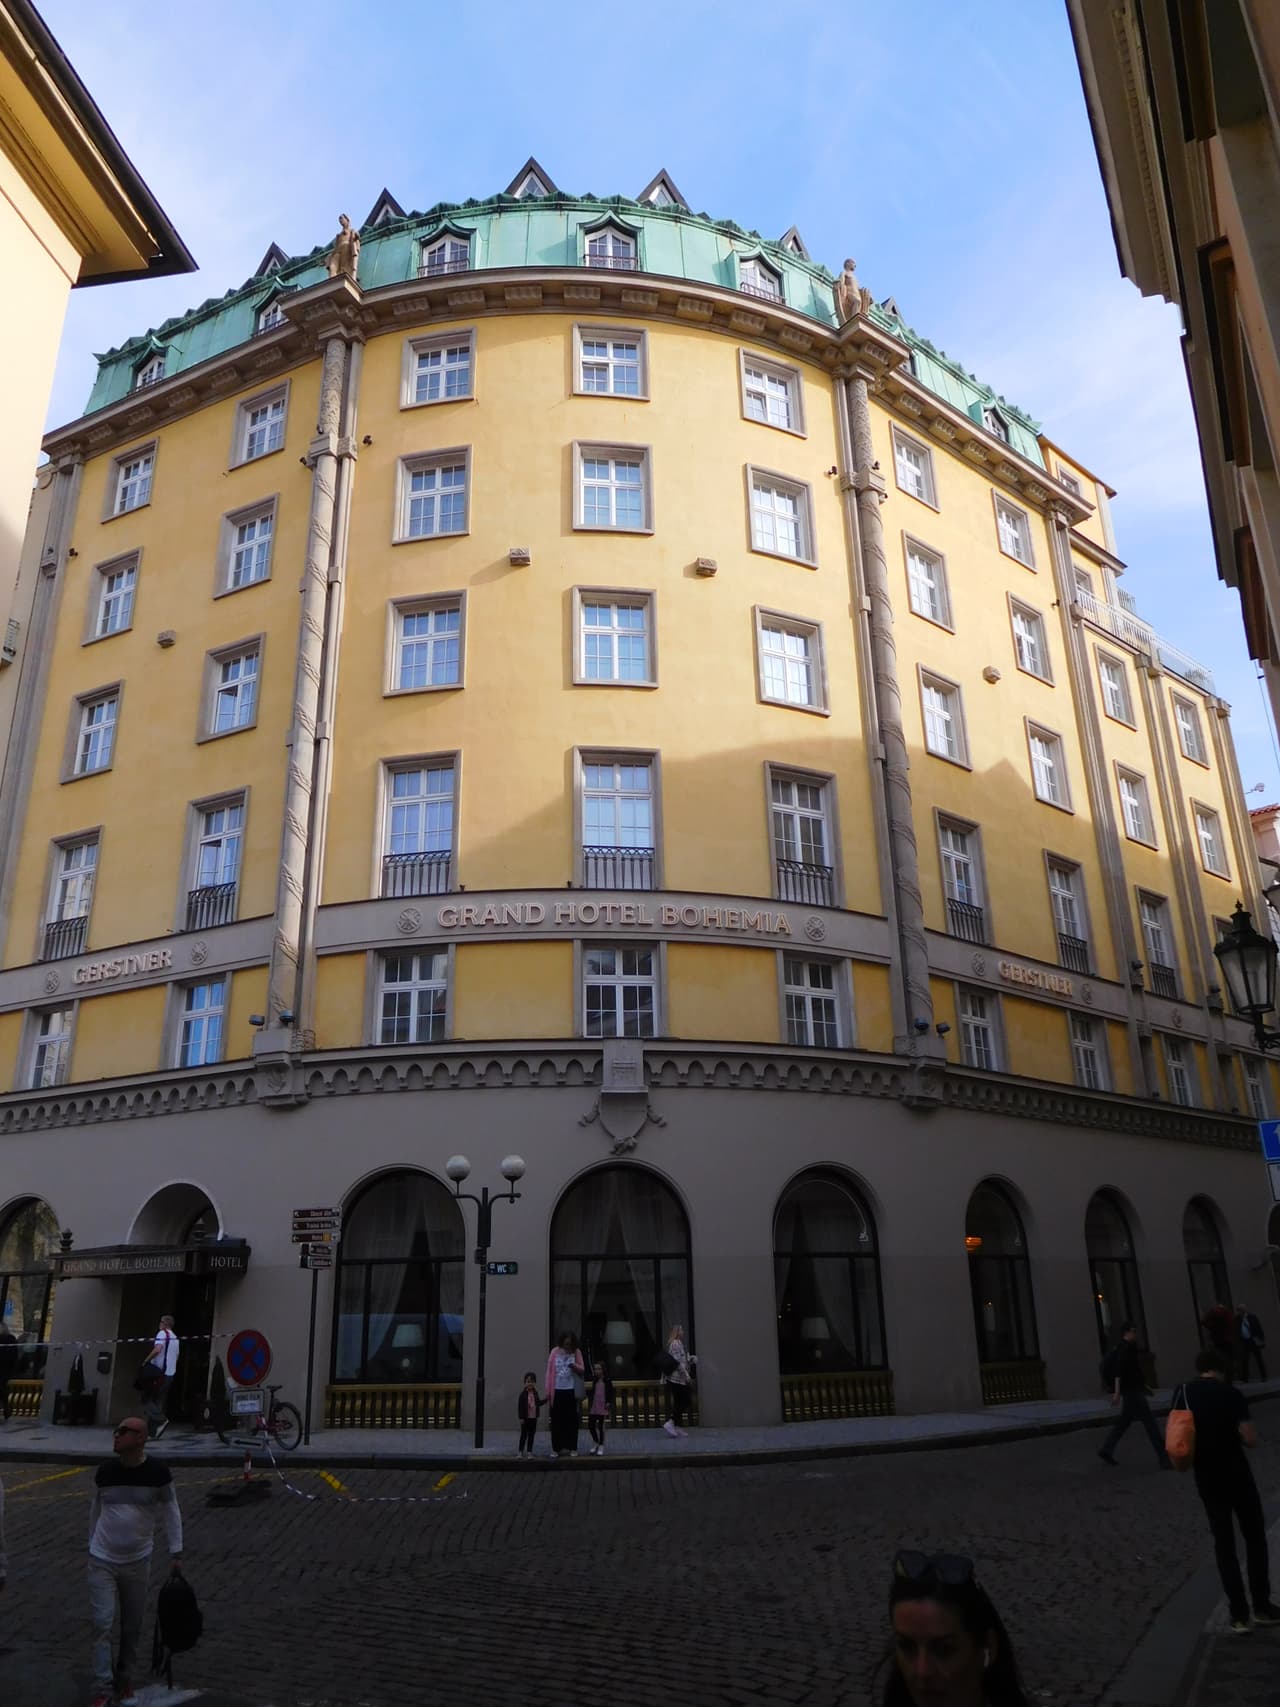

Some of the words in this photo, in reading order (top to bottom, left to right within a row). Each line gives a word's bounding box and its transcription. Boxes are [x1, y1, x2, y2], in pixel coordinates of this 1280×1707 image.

[438, 903, 546, 927] GRAND
[553, 902, 654, 925] HOTEL
[660, 905, 792, 935] BOHEMIA
[73, 949, 172, 984] GERSTNER
[998, 960, 1073, 995] GERSTNER
[63, 1261, 97, 1273] GRAND
[100, 1258, 129, 1271] HOTEL
[135, 1256, 182, 1269] BOHEMIA
[210, 1256, 243, 1269] HOTEL
[497, 1264, 507, 1273] WC
